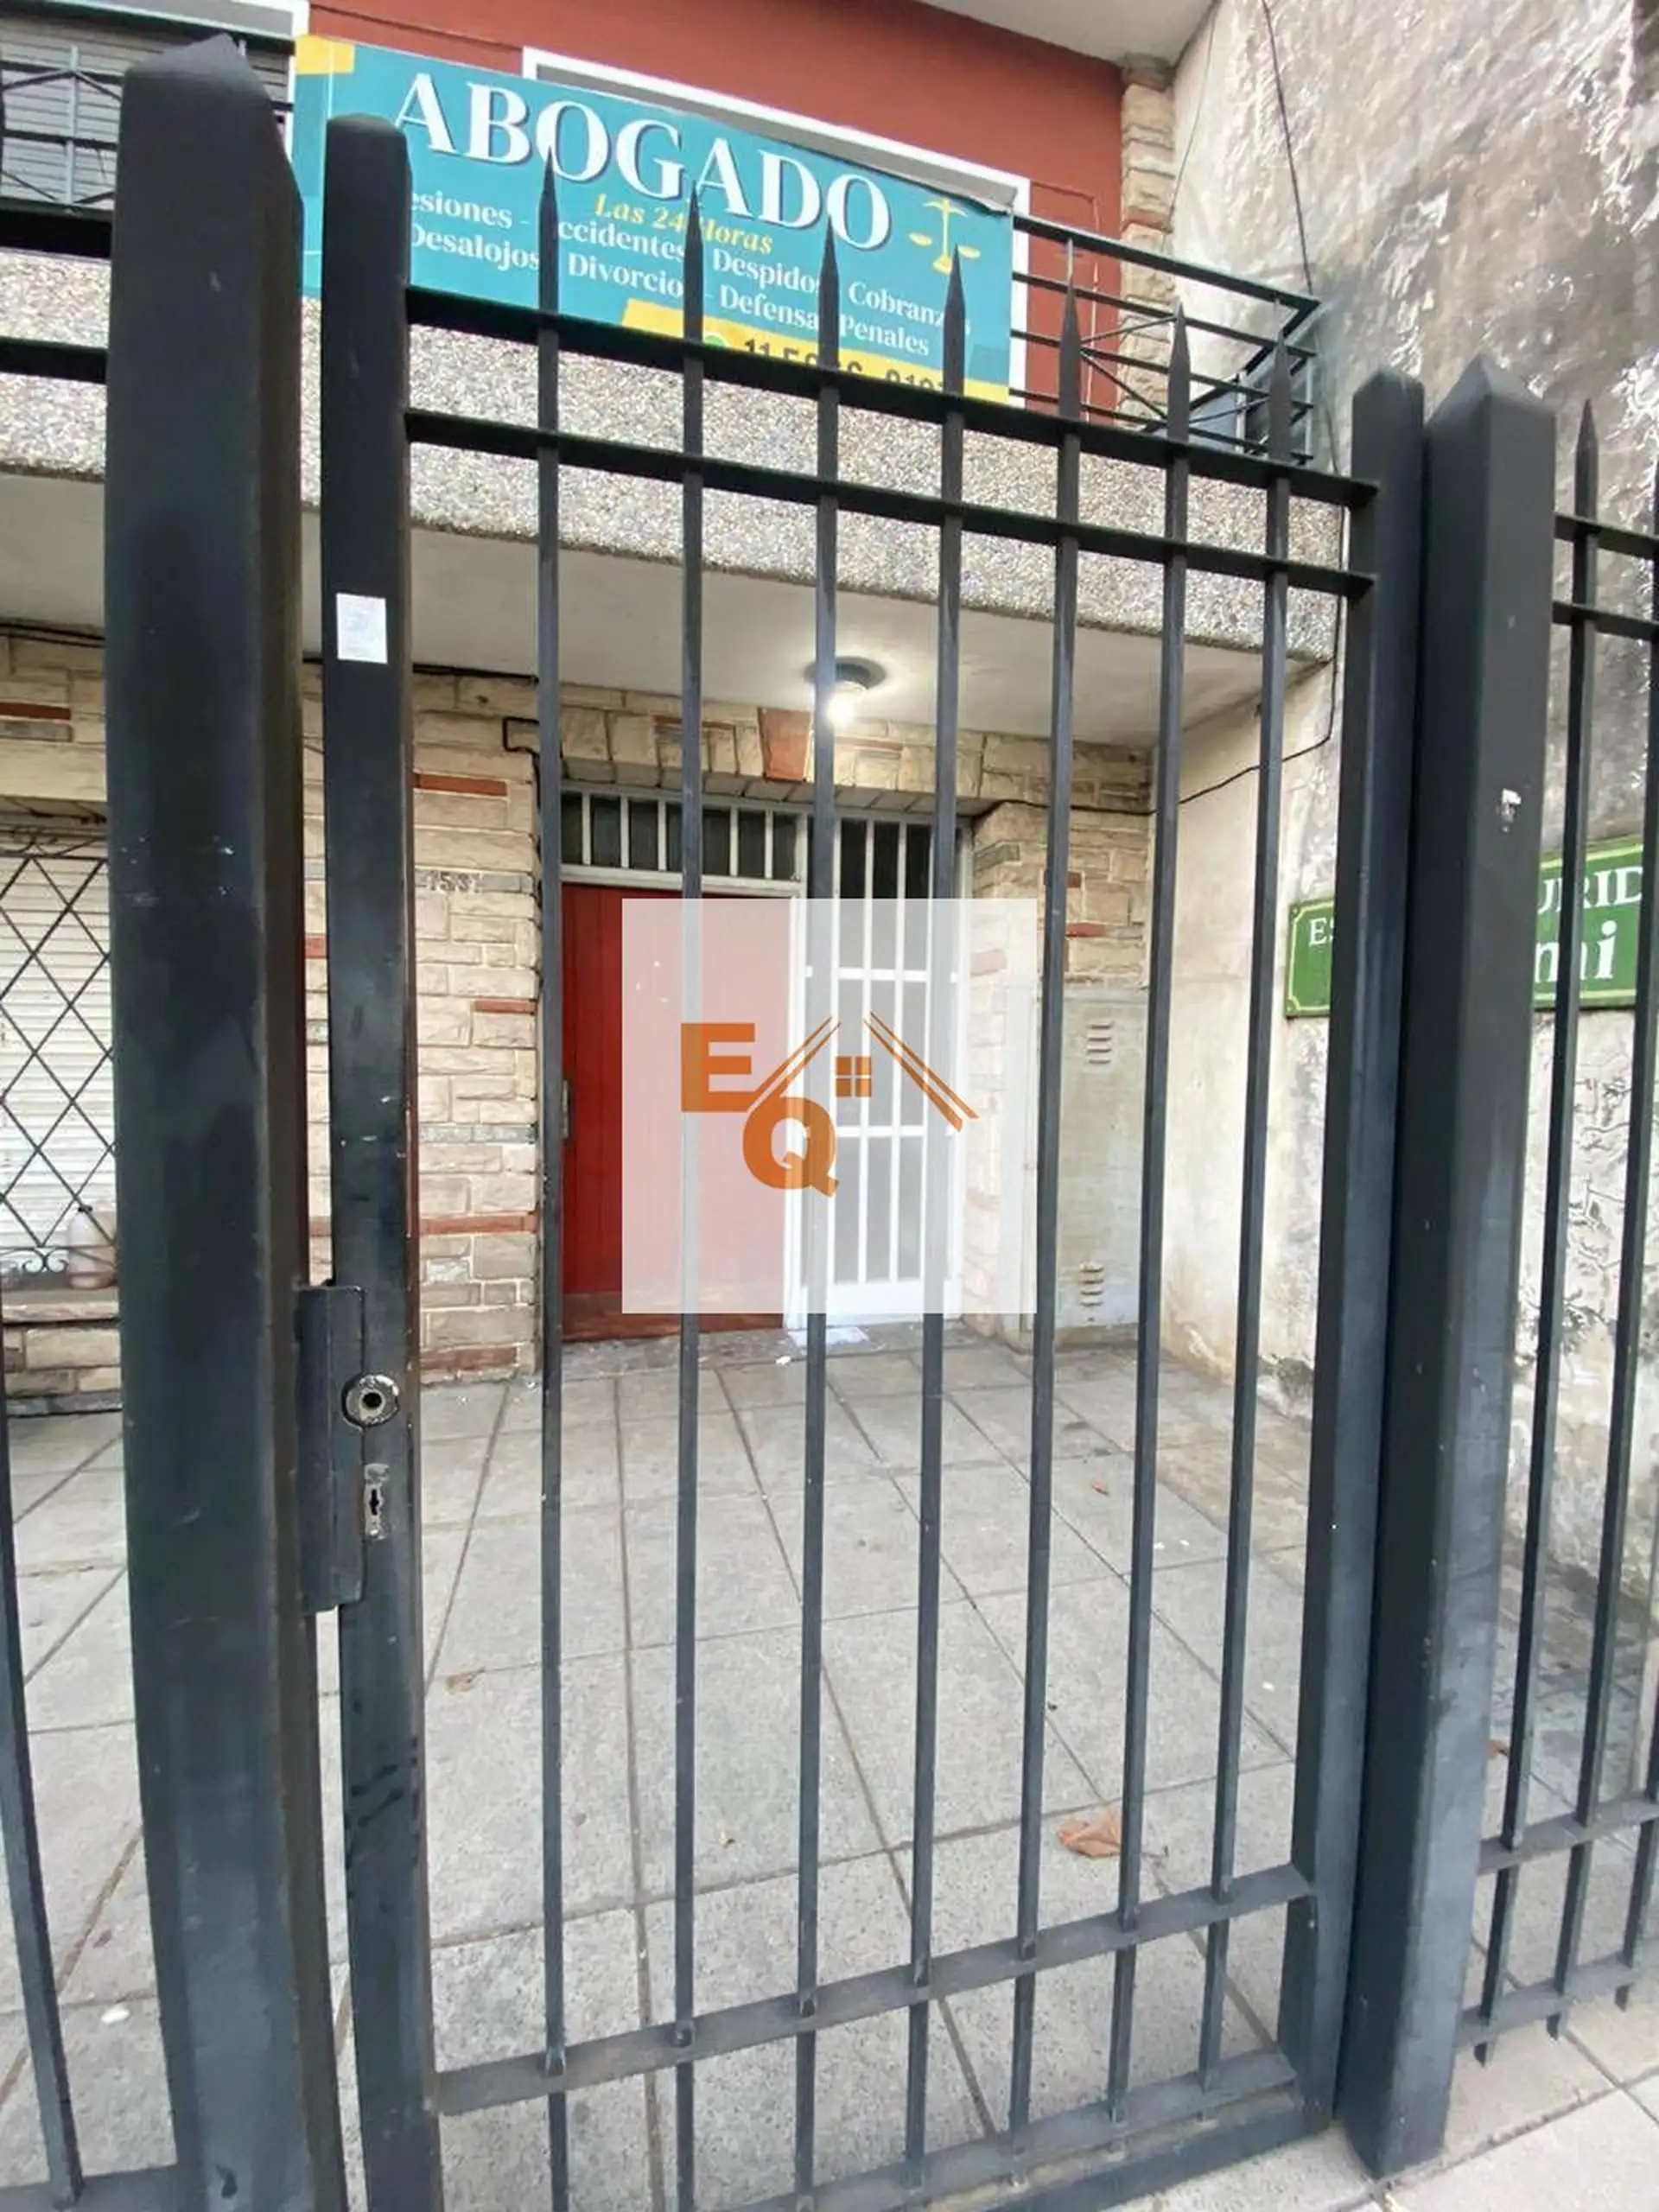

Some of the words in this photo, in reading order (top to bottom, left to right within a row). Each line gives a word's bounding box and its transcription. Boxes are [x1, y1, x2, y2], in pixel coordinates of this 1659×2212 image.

[395, 72, 890, 250] ABOGADO
[594, 193, 645, 224] Las
[712, 247, 820, 294] Despido
[839, 314, 931, 356] Penales
